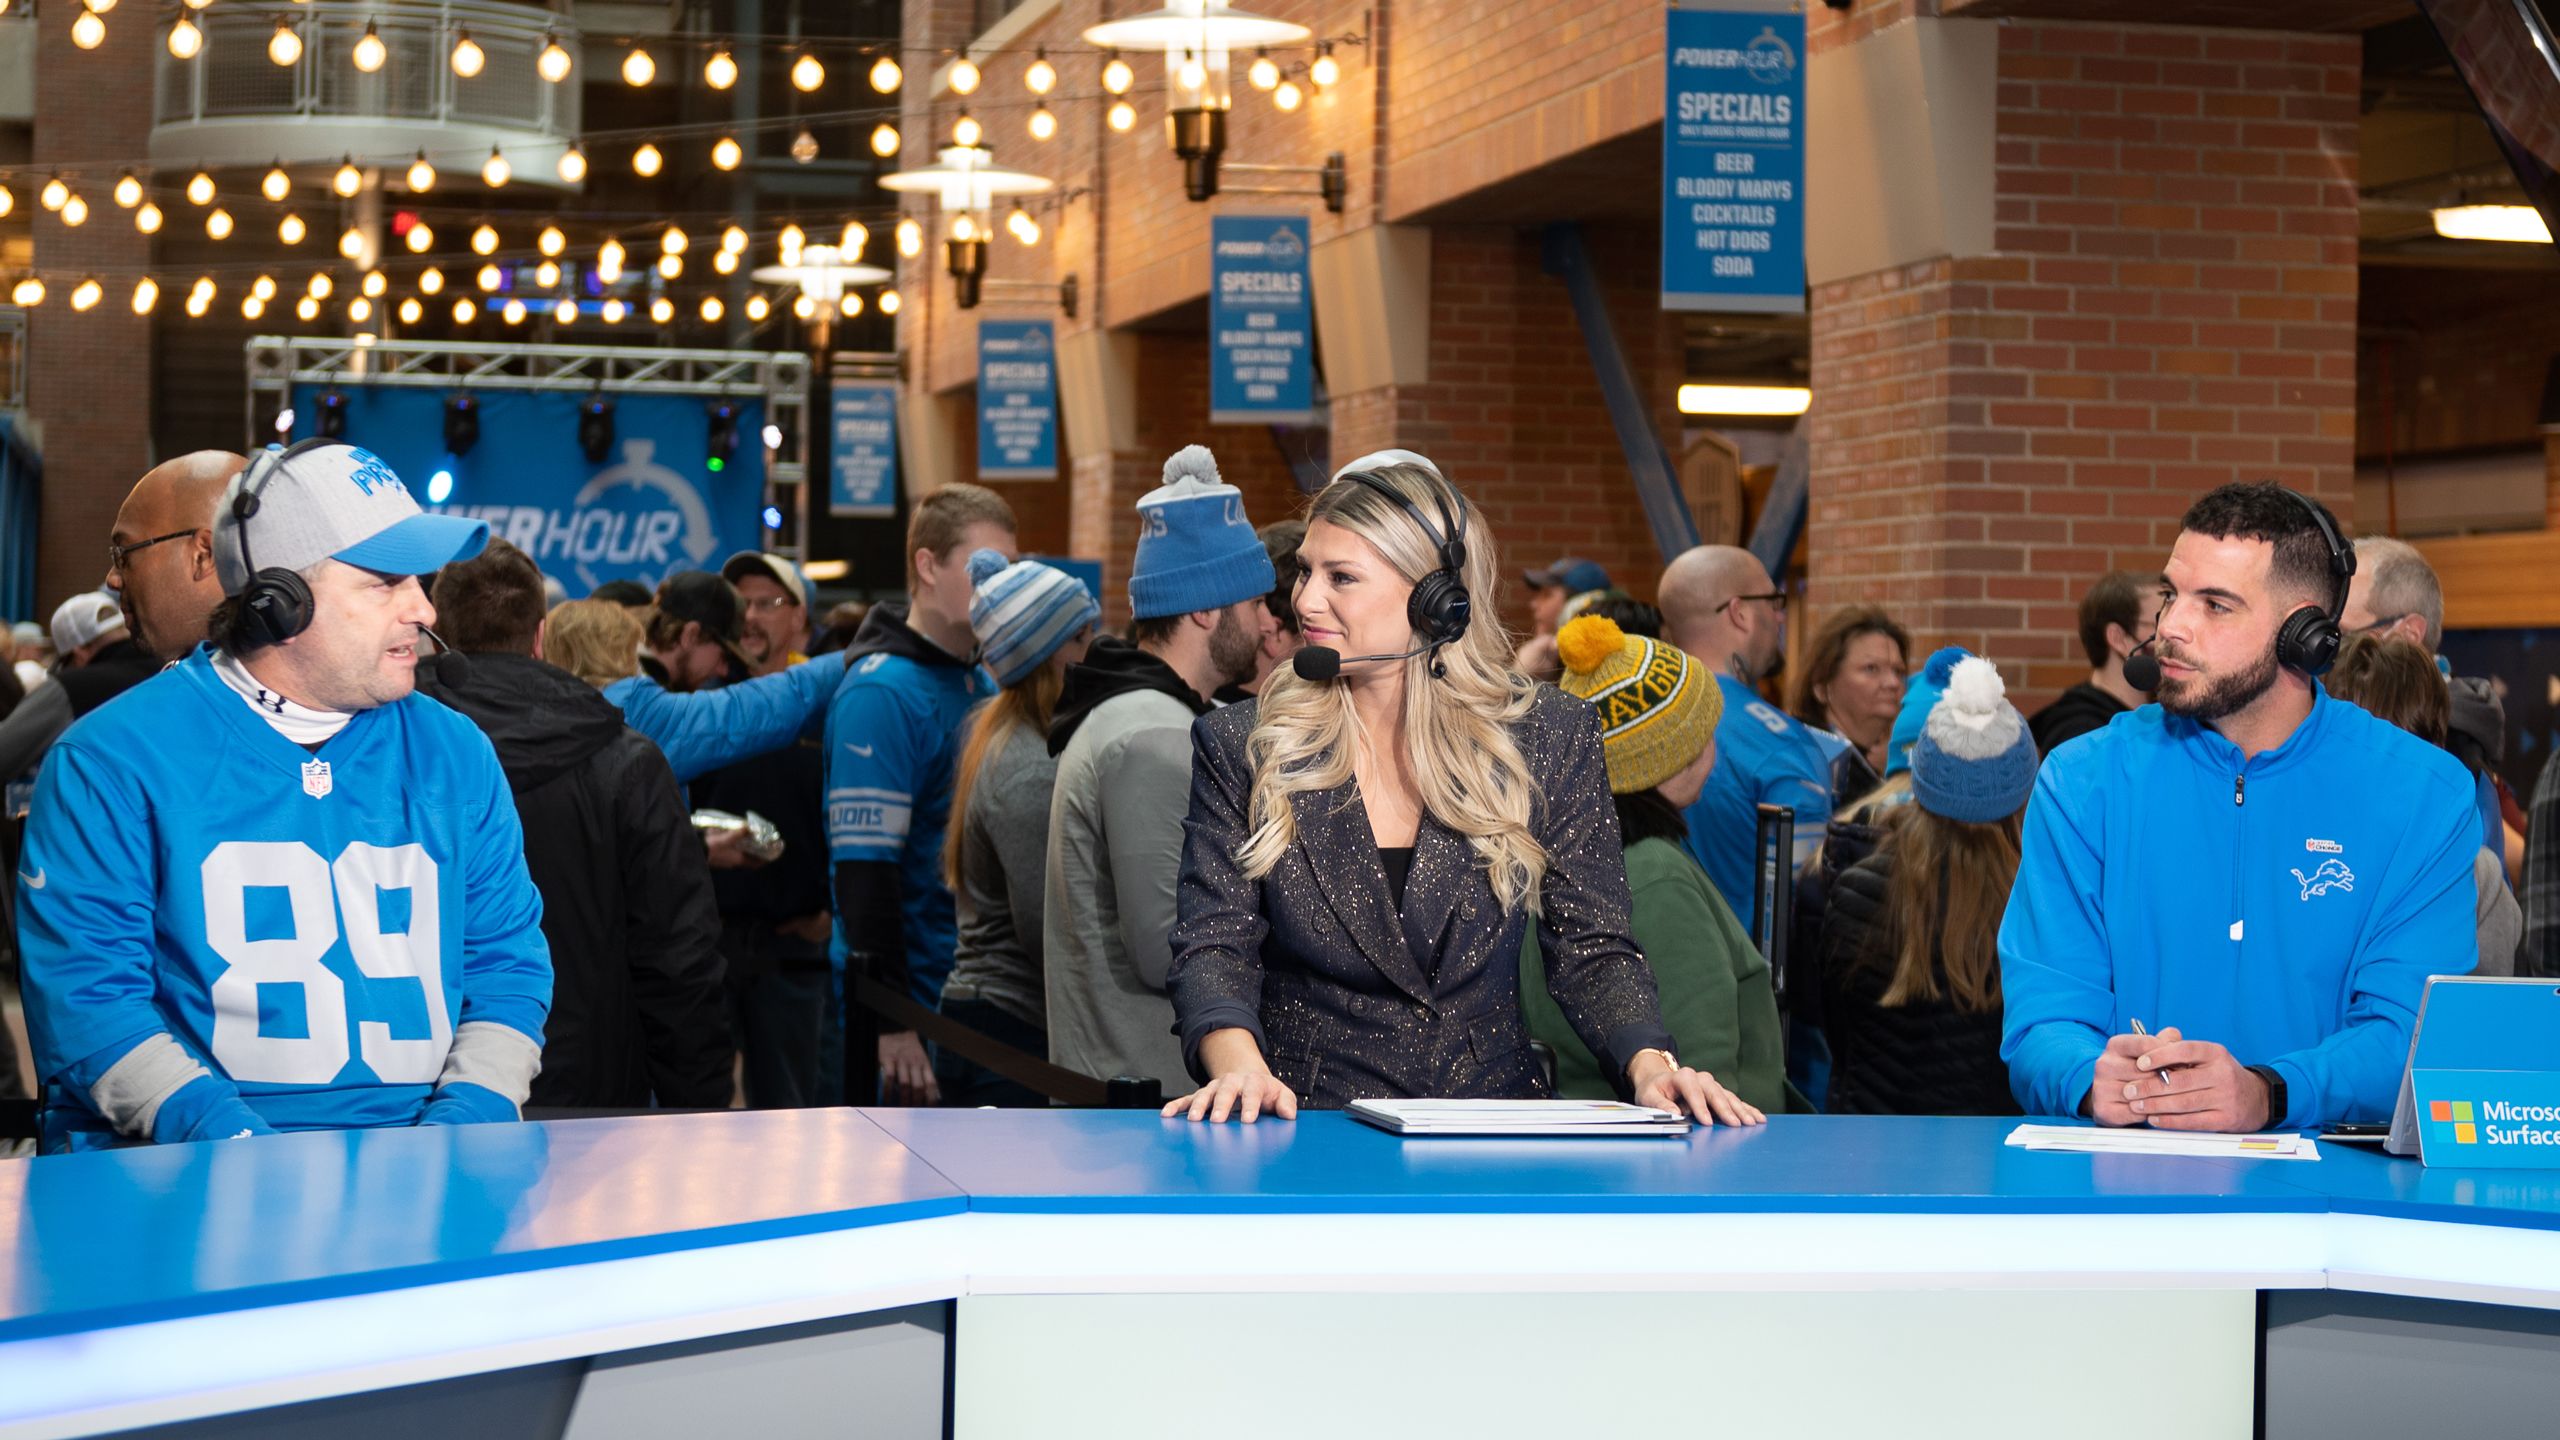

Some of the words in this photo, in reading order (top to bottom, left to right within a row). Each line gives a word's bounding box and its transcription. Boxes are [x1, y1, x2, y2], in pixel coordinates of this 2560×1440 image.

[1678, 92, 1791, 123] SPECIALS
[1715, 152, 1754, 173] BEER
[1677, 177, 1735, 199] BLOODY
[1738, 179, 1792, 201] MARYS
[1692, 203, 1776, 227] COCKTAILS
[1696, 229, 1727, 251] HOT
[1730, 230, 1770, 252] DOGS
[1713, 255, 1754, 277] SODA
[201, 841, 453, 1084] 89
